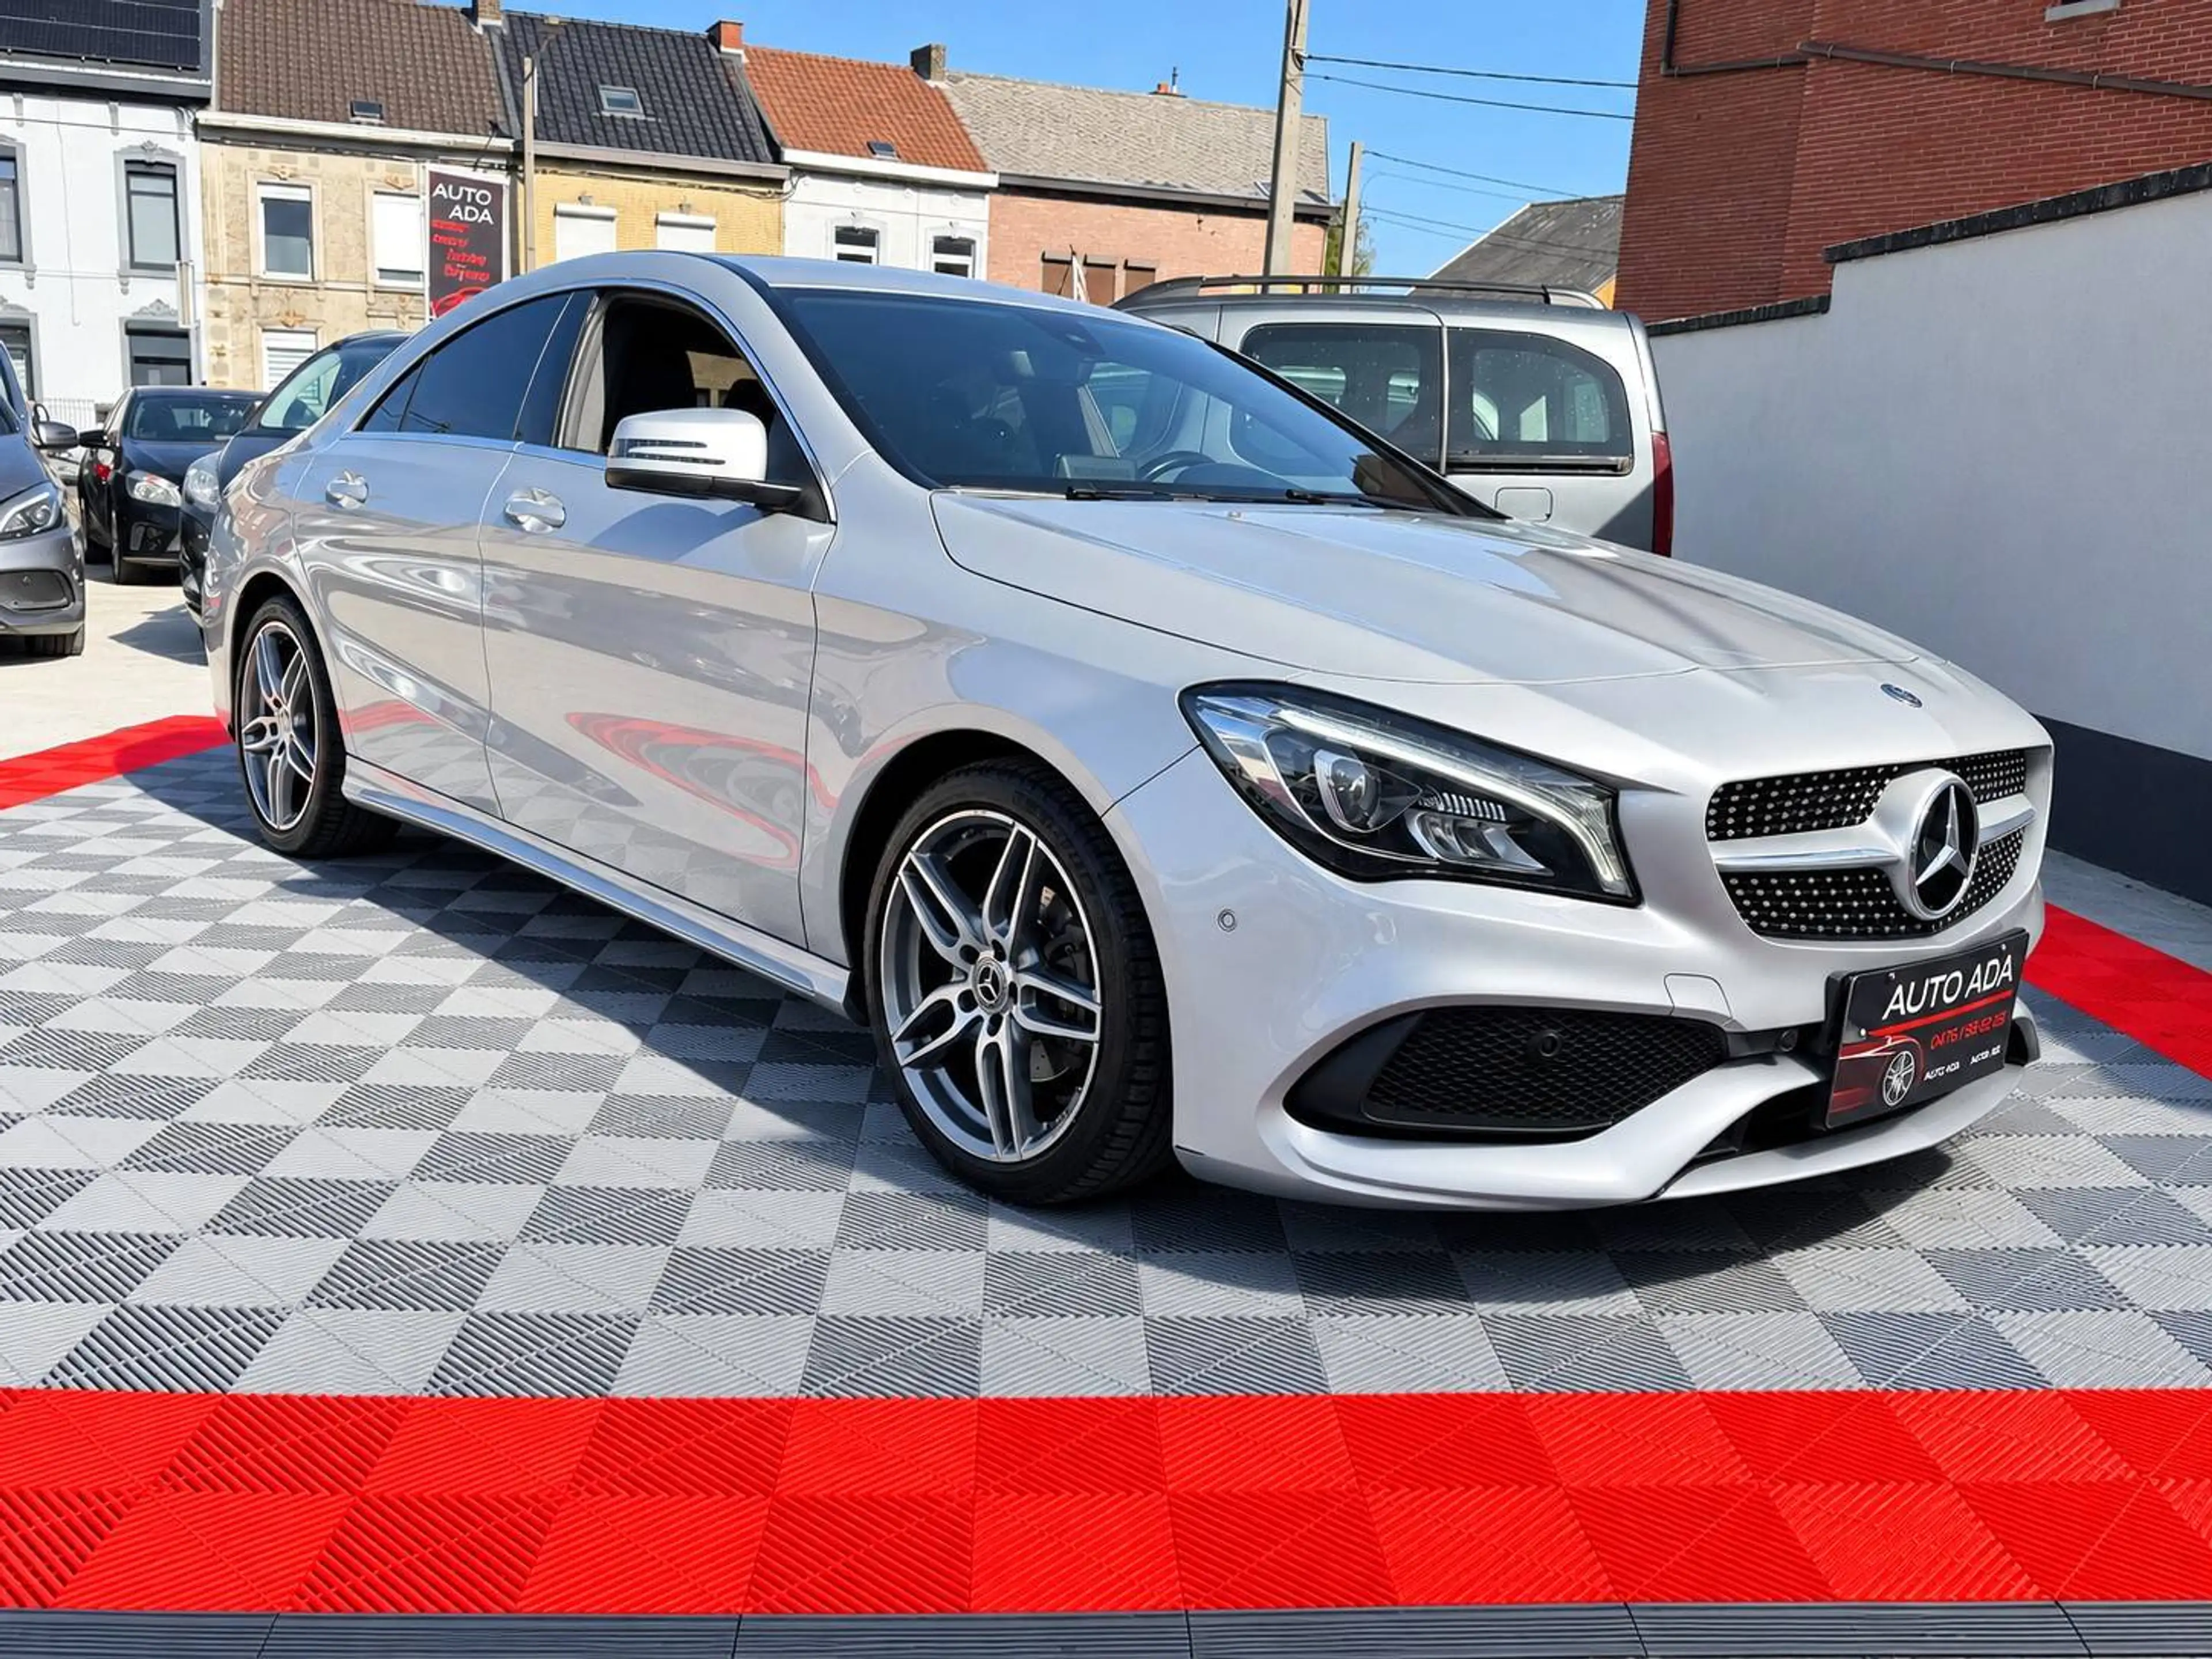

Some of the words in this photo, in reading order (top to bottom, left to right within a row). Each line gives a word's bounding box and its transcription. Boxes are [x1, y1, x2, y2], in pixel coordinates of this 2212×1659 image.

[433, 183, 491, 206] AUTO
[449, 205, 494, 225] ADA
[1882, 971, 1963, 1020] AUTO
[1965, 955, 2013, 998] ADA
